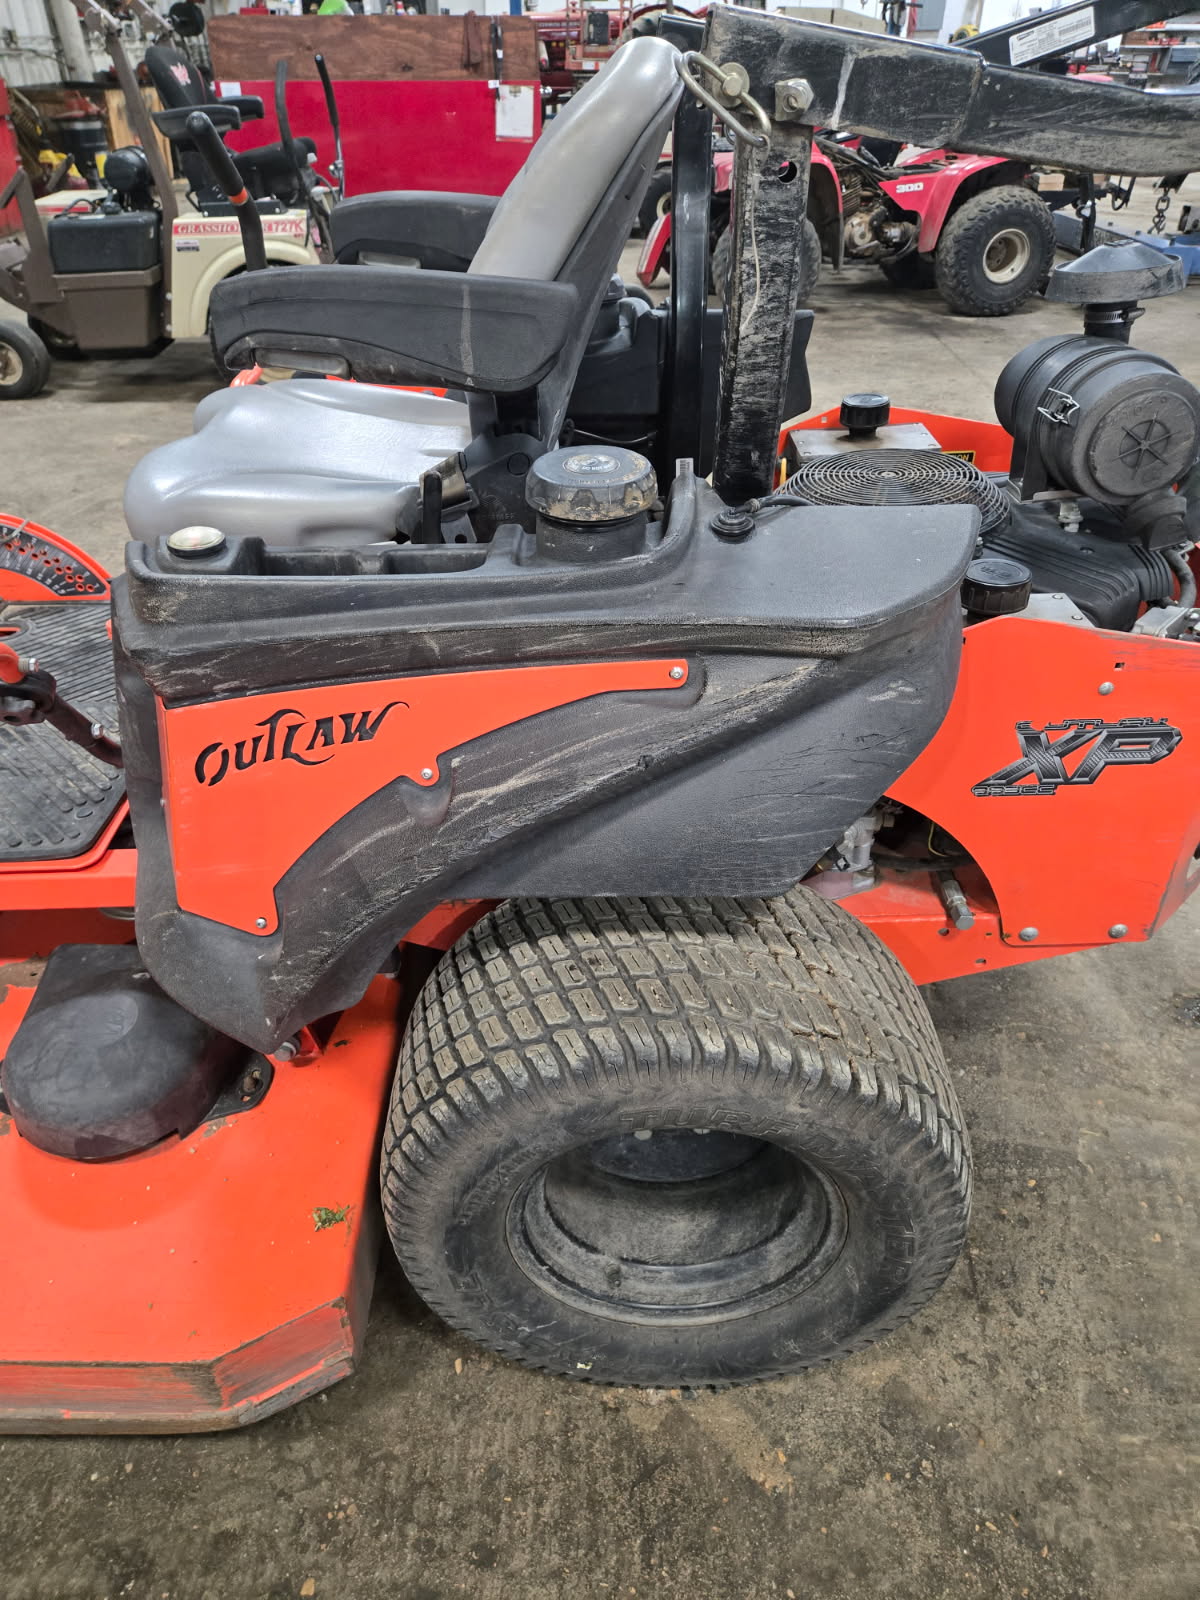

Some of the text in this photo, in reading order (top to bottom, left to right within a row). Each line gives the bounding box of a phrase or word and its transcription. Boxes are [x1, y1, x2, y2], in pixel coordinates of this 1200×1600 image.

[896, 182, 924, 193] 300
[273, 218, 305, 233] 727K
[195, 701, 409, 786] OUTLAW
[975, 728, 1183, 784] XP
[619, 1105, 800, 1137] TURF
